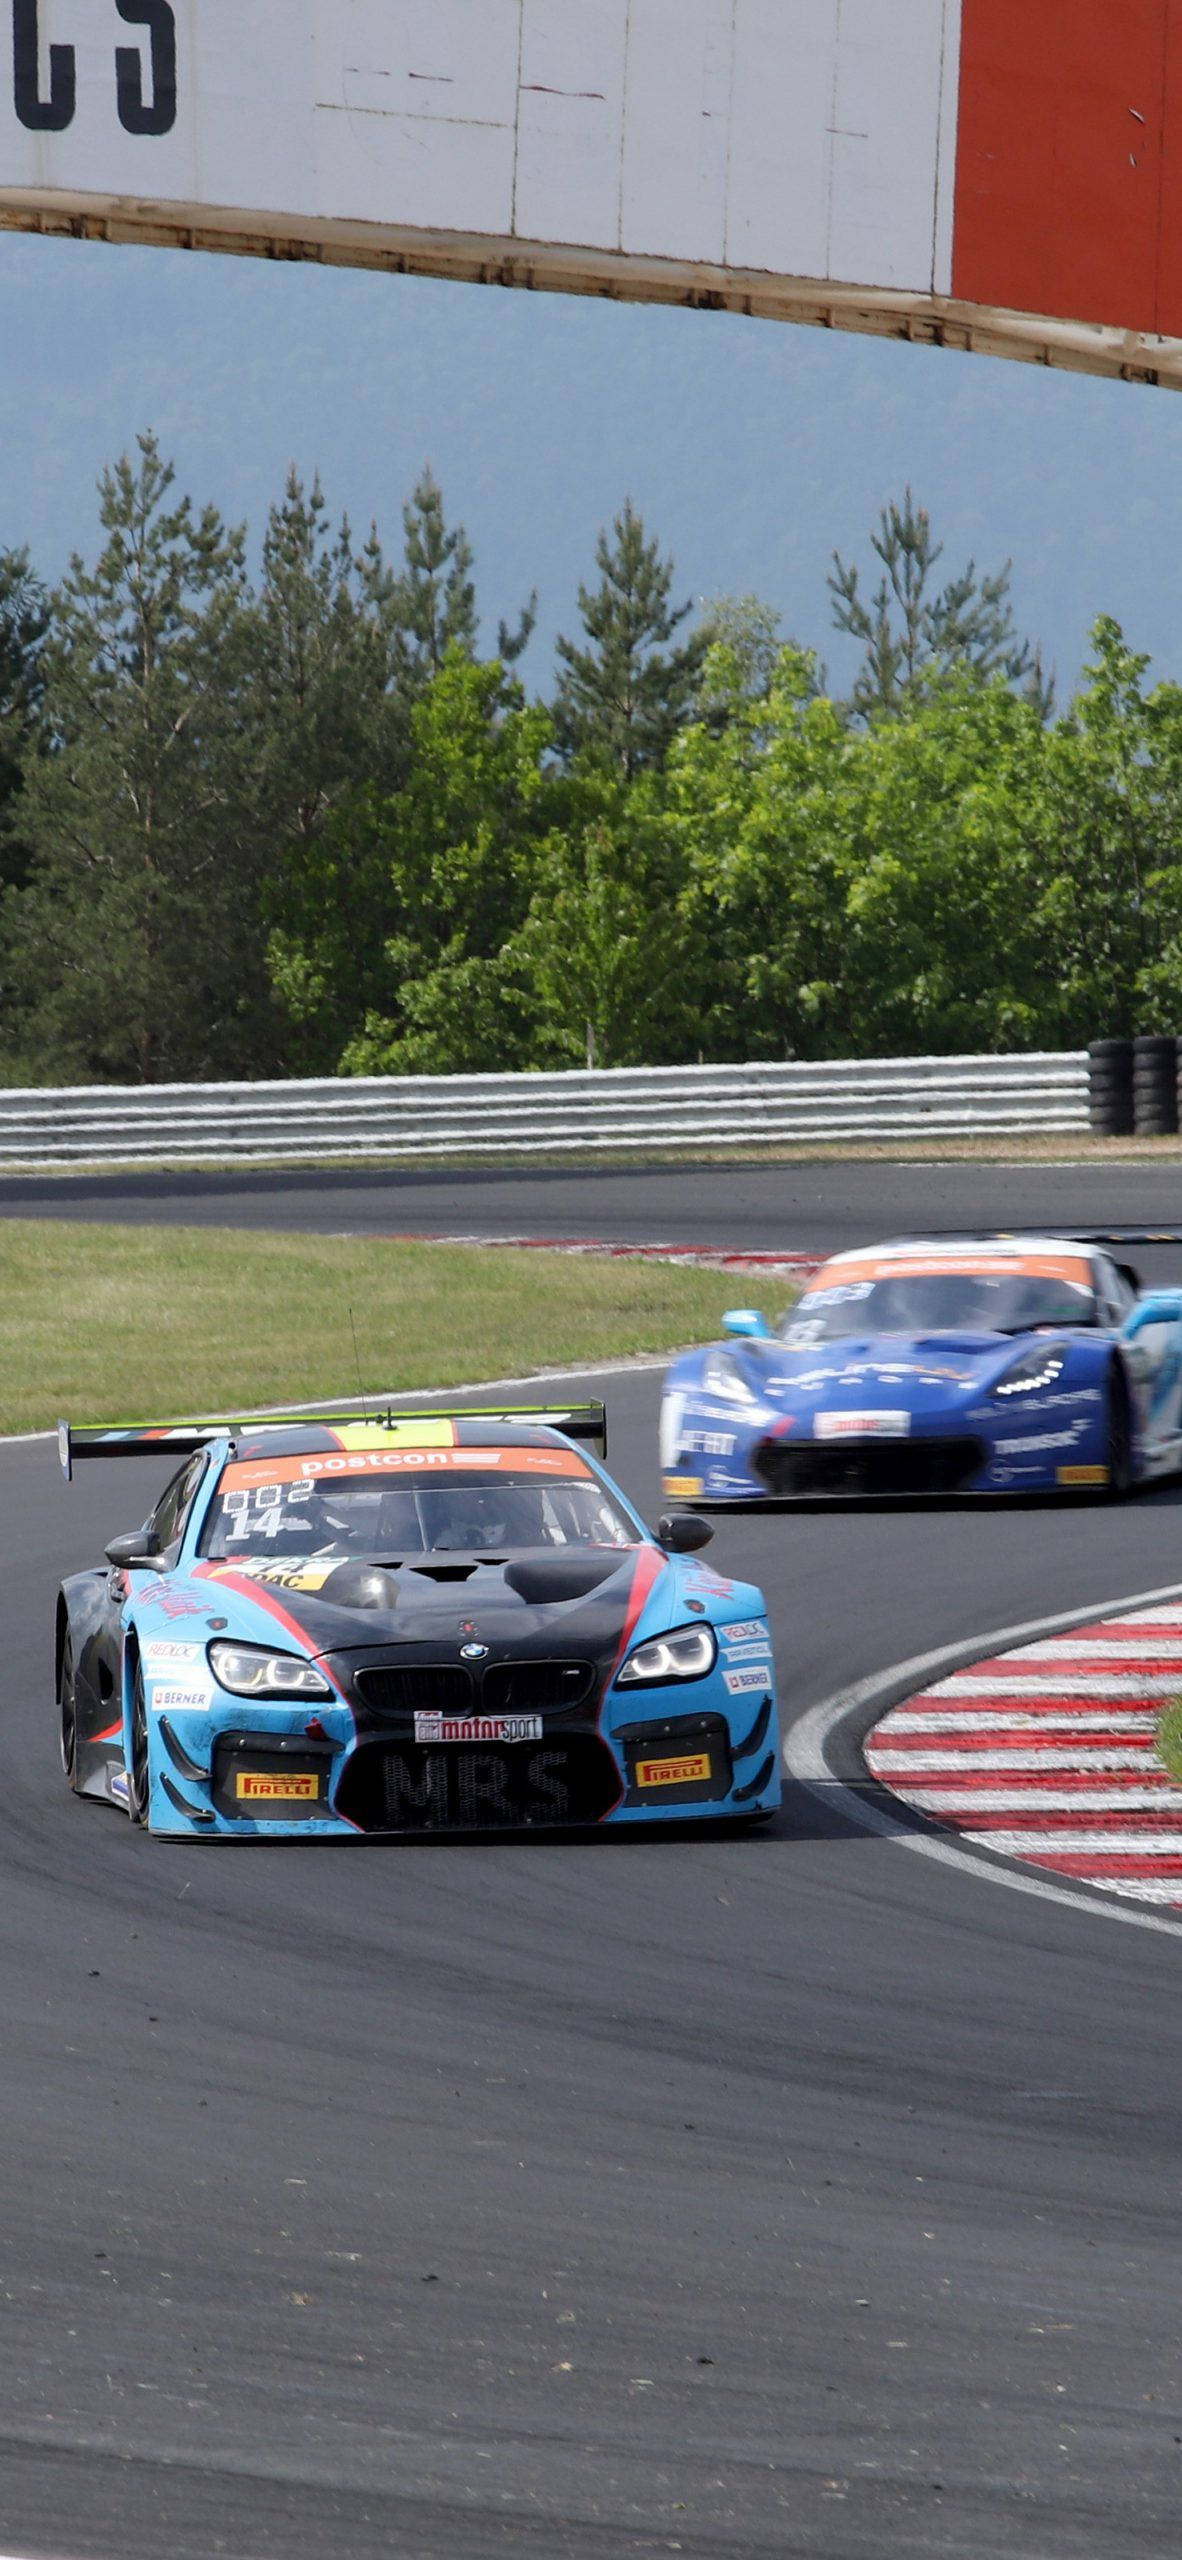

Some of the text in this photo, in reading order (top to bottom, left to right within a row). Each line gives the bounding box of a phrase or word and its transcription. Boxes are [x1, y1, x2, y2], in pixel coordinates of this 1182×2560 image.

[300, 1453, 448, 1477] postcon
[222, 1478, 316, 1514] 002
[225, 1507, 285, 1541] 14
[163, 1692, 206, 1704] BERNER
[441, 1717, 539, 1740] motorsport
[643, 1759, 704, 1782] PIRELLI
[244, 1777, 312, 1795] PIRELLI
[383, 1751, 569, 1822] MRS
